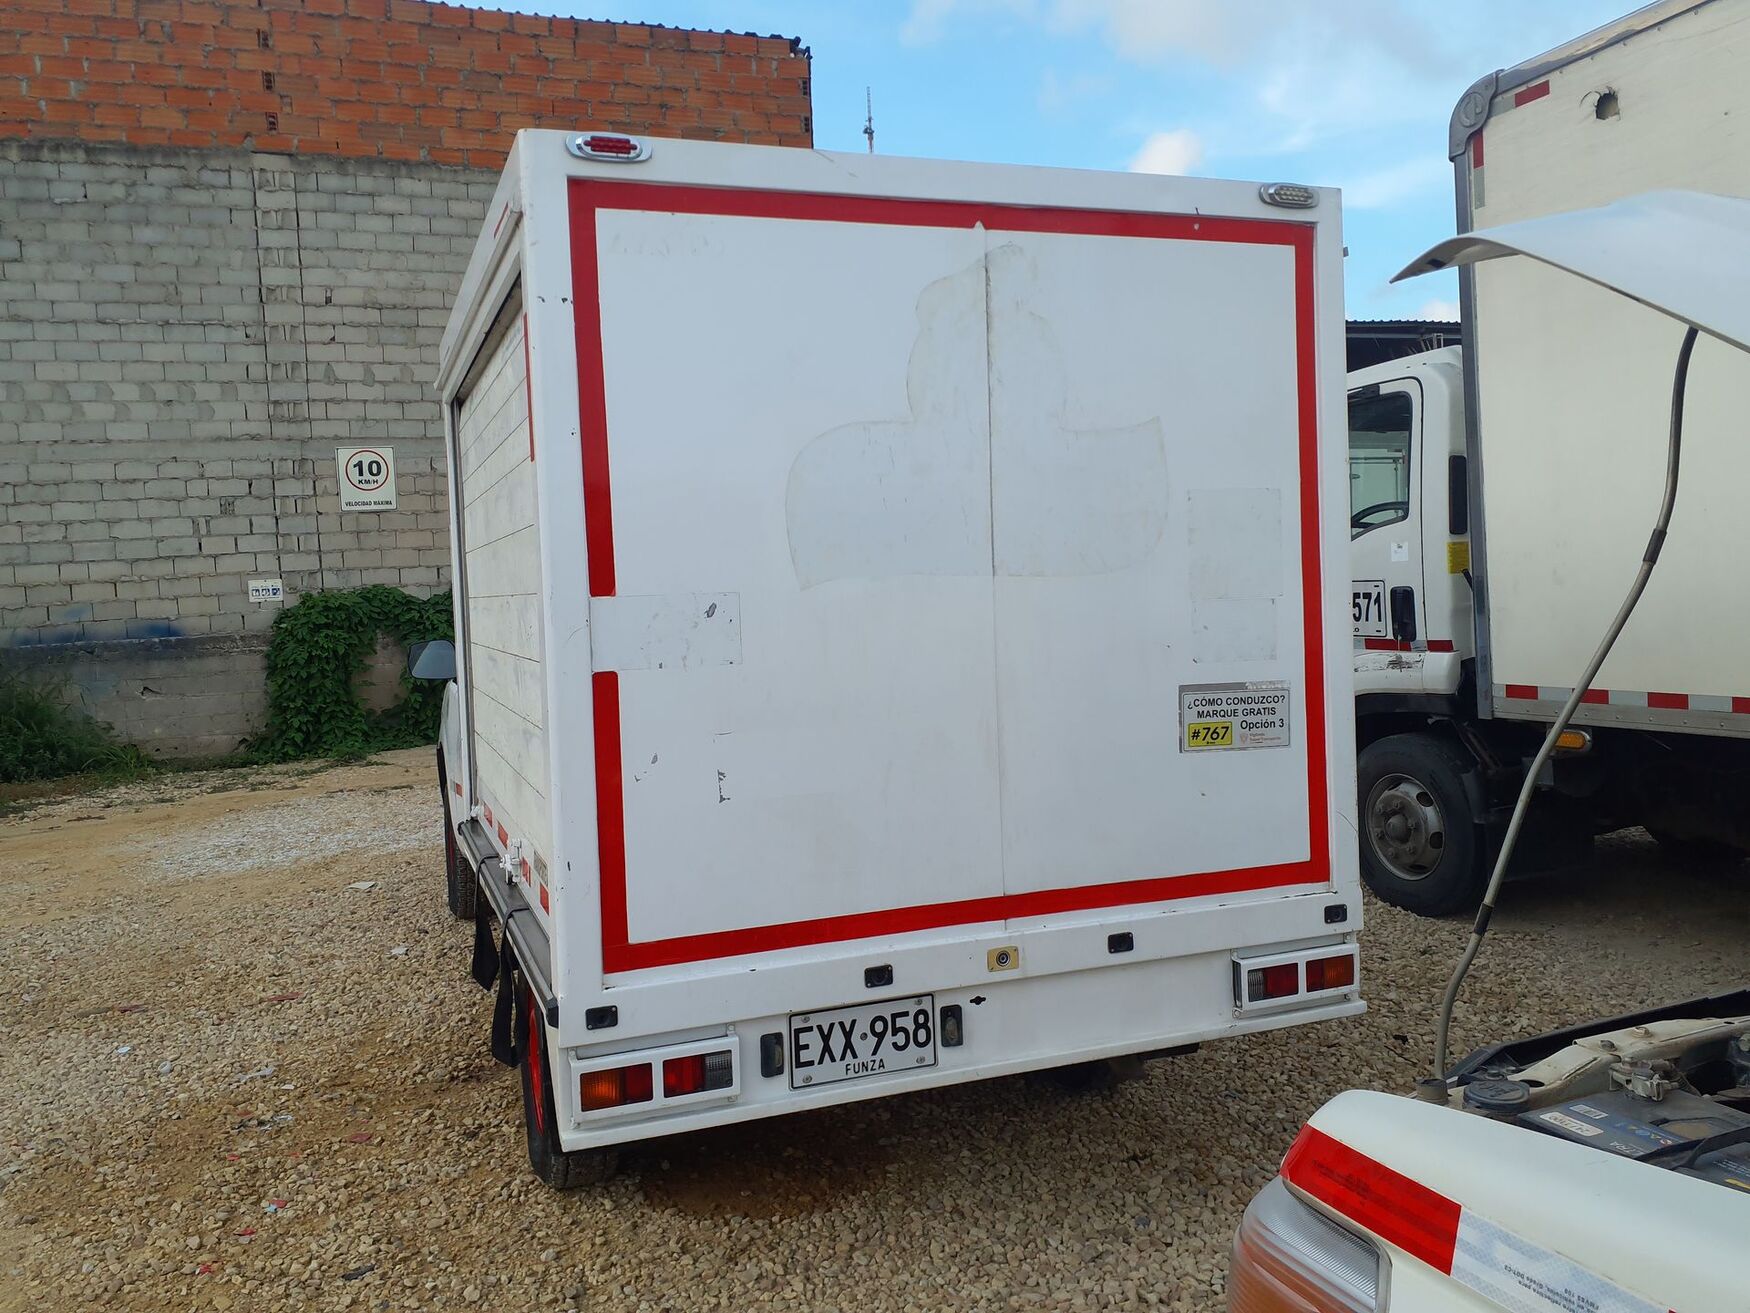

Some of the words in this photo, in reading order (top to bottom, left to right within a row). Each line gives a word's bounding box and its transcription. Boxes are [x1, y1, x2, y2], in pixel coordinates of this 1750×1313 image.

[353, 460, 382, 477] 10
[1352, 592, 1382, 623] 571
[1225, 695, 1286, 706] CONDUZCO?
[1197, 708, 1239, 719] MARQUE
[1242, 706, 1277, 717] GRATIS
[1240, 719, 1276, 731] Opción
[1278, 719, 1285, 728] 3
[1191, 726, 1230, 741] #767
[845, 1058, 886, 1076] FUNZA
